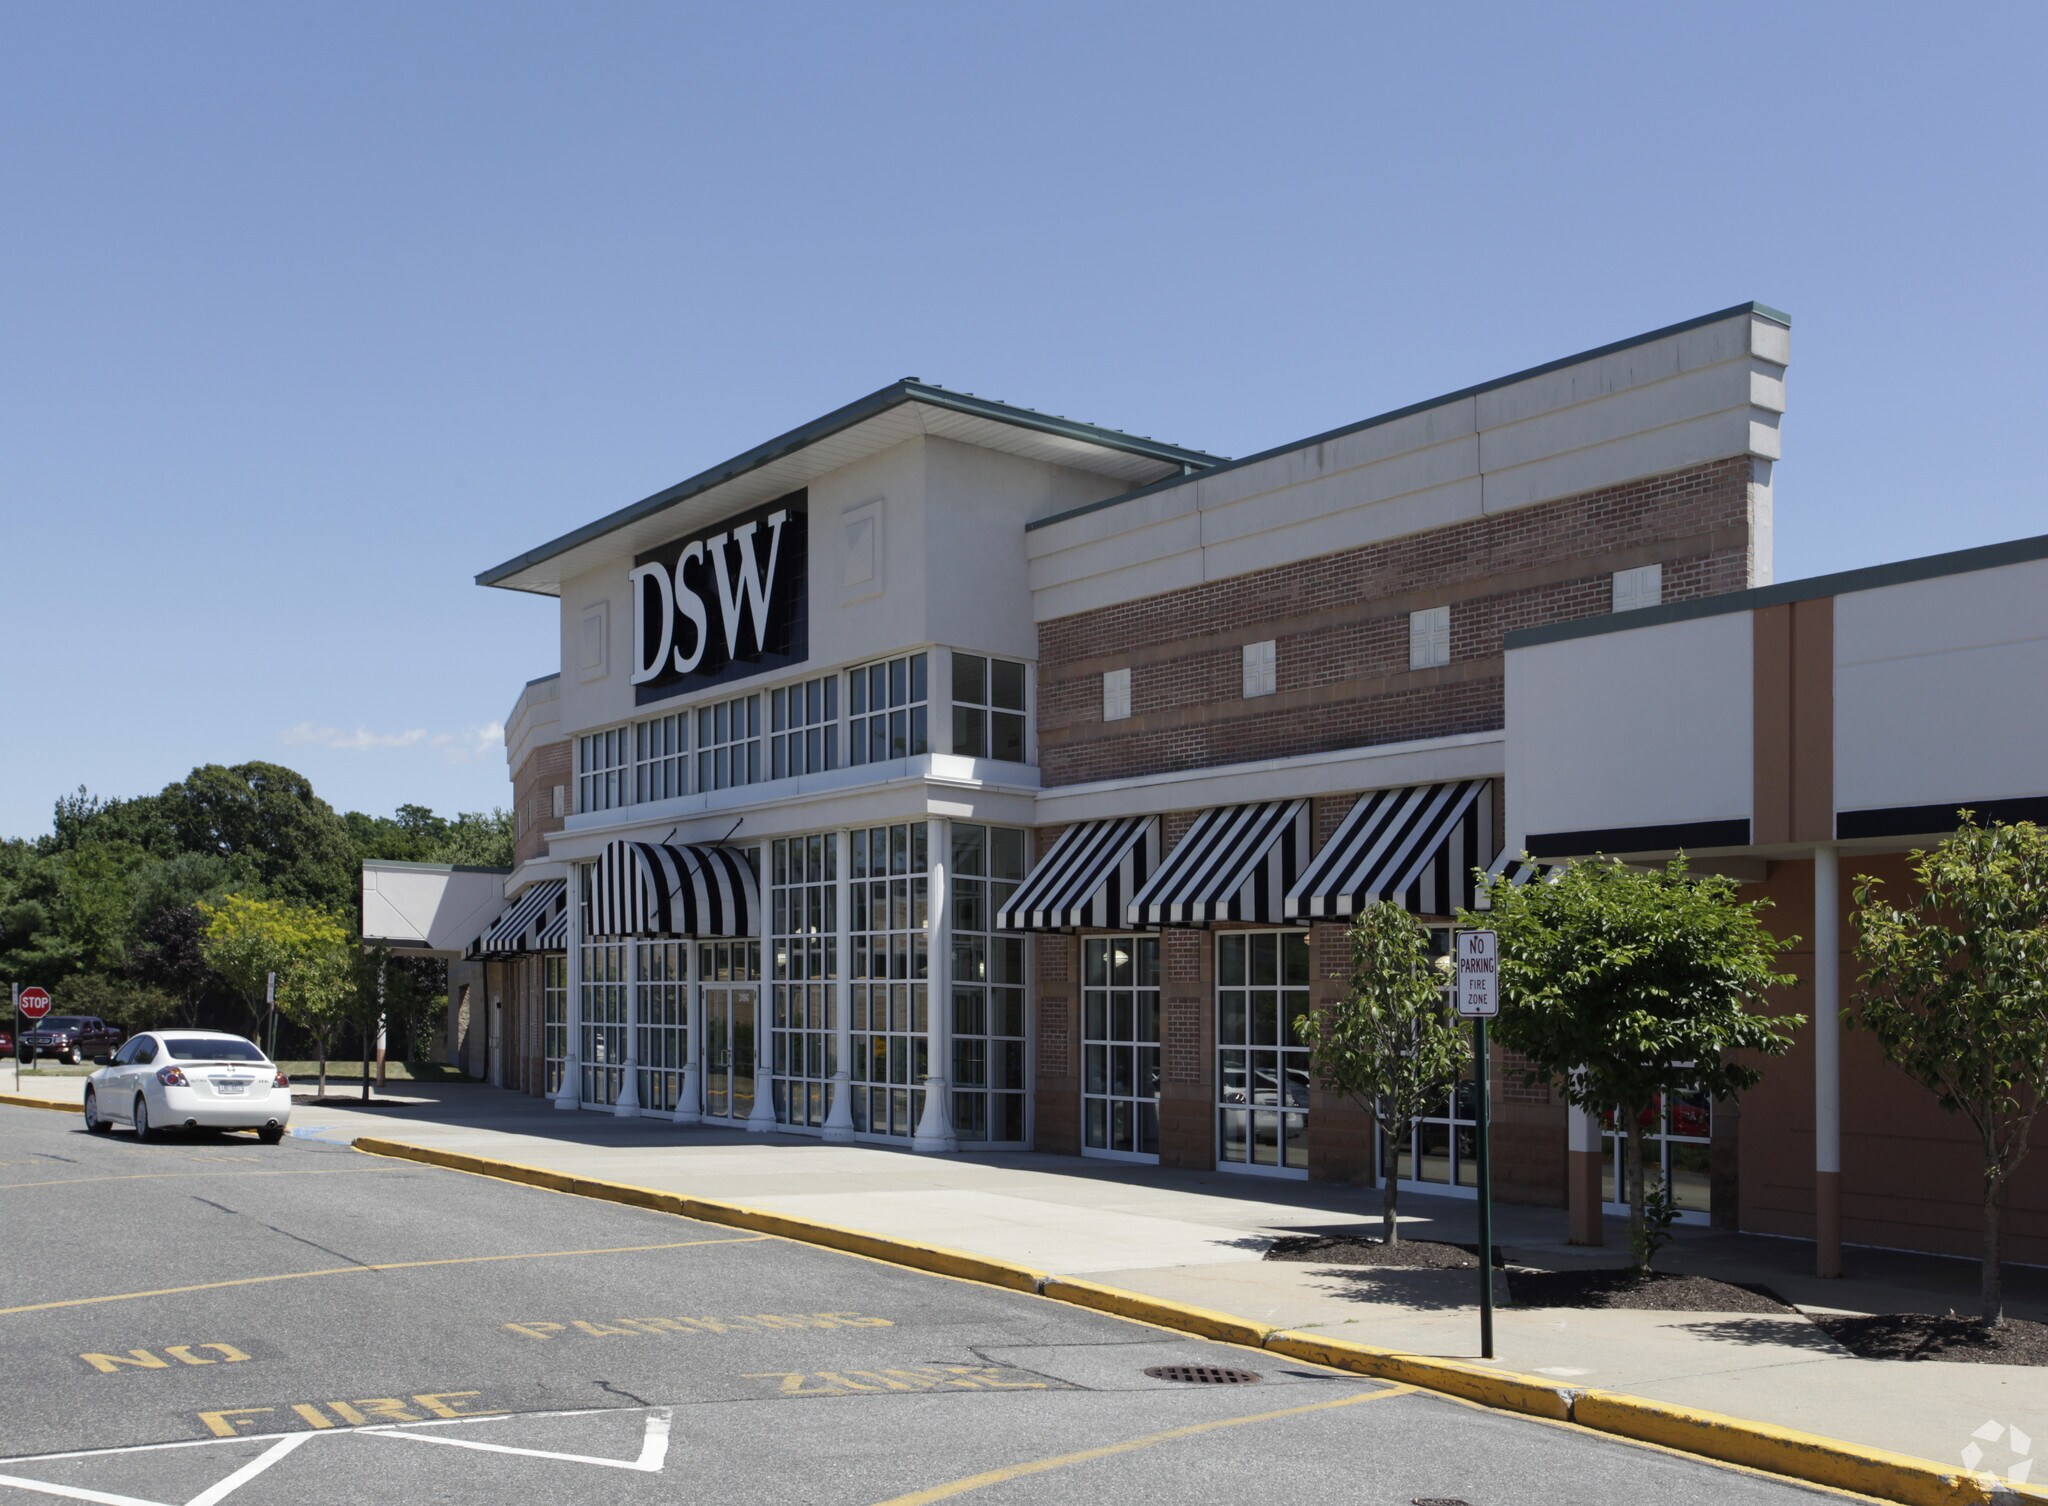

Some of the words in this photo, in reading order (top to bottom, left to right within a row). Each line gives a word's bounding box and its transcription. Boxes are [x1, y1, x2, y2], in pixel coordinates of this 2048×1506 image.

[628, 508, 787, 686] DSW
[1470, 938, 1484, 954] NO
[1461, 957, 1494, 973] PARKING
[1470, 979, 1486, 990] FIRE
[22, 996, 49, 1009] STOP
[1468, 993, 1488, 1005] ZONE
[78, 1343, 252, 1373] NO
[503, 1311, 895, 1340] PARKING
[198, 1390, 510, 1437] FIRE
